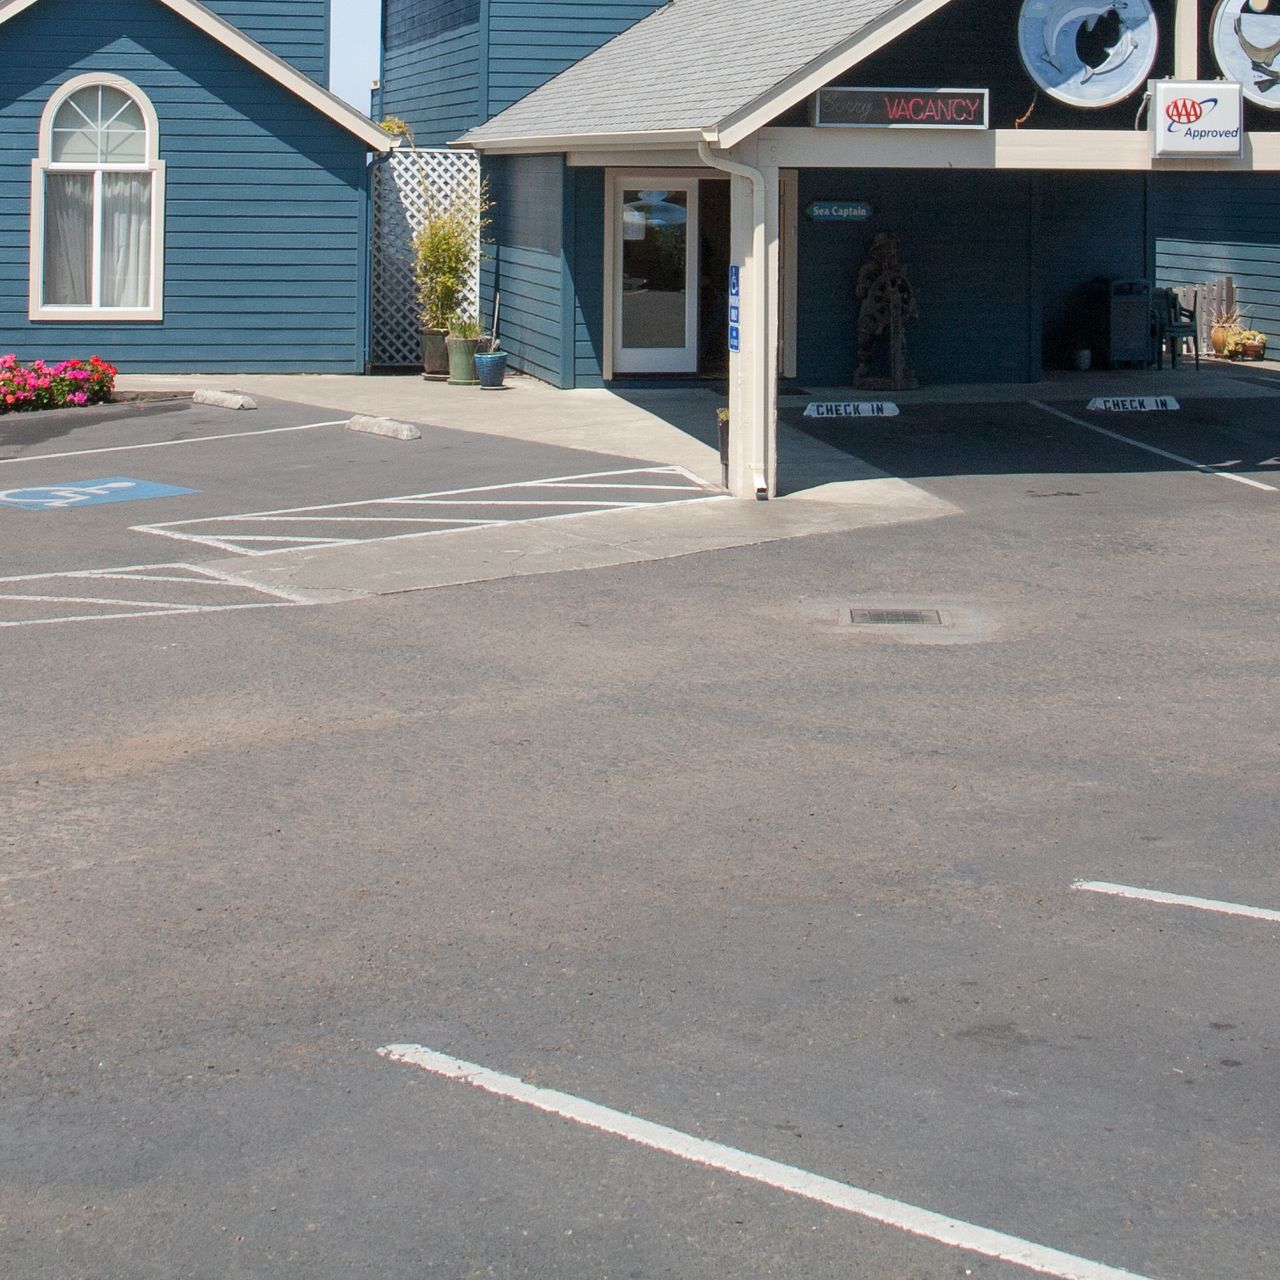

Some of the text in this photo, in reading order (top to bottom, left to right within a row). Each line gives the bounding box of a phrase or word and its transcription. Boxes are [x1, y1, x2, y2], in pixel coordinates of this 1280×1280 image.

[884, 96, 979, 121] VACANCY
[1169, 99, 1201, 124] AAA
[1184, 127, 1239, 139] Approved
[813, 206, 866, 217] Sea Captain
[816, 404, 884, 416] CHECK IN
[1103, 399, 1168, 411] CHECK IN
